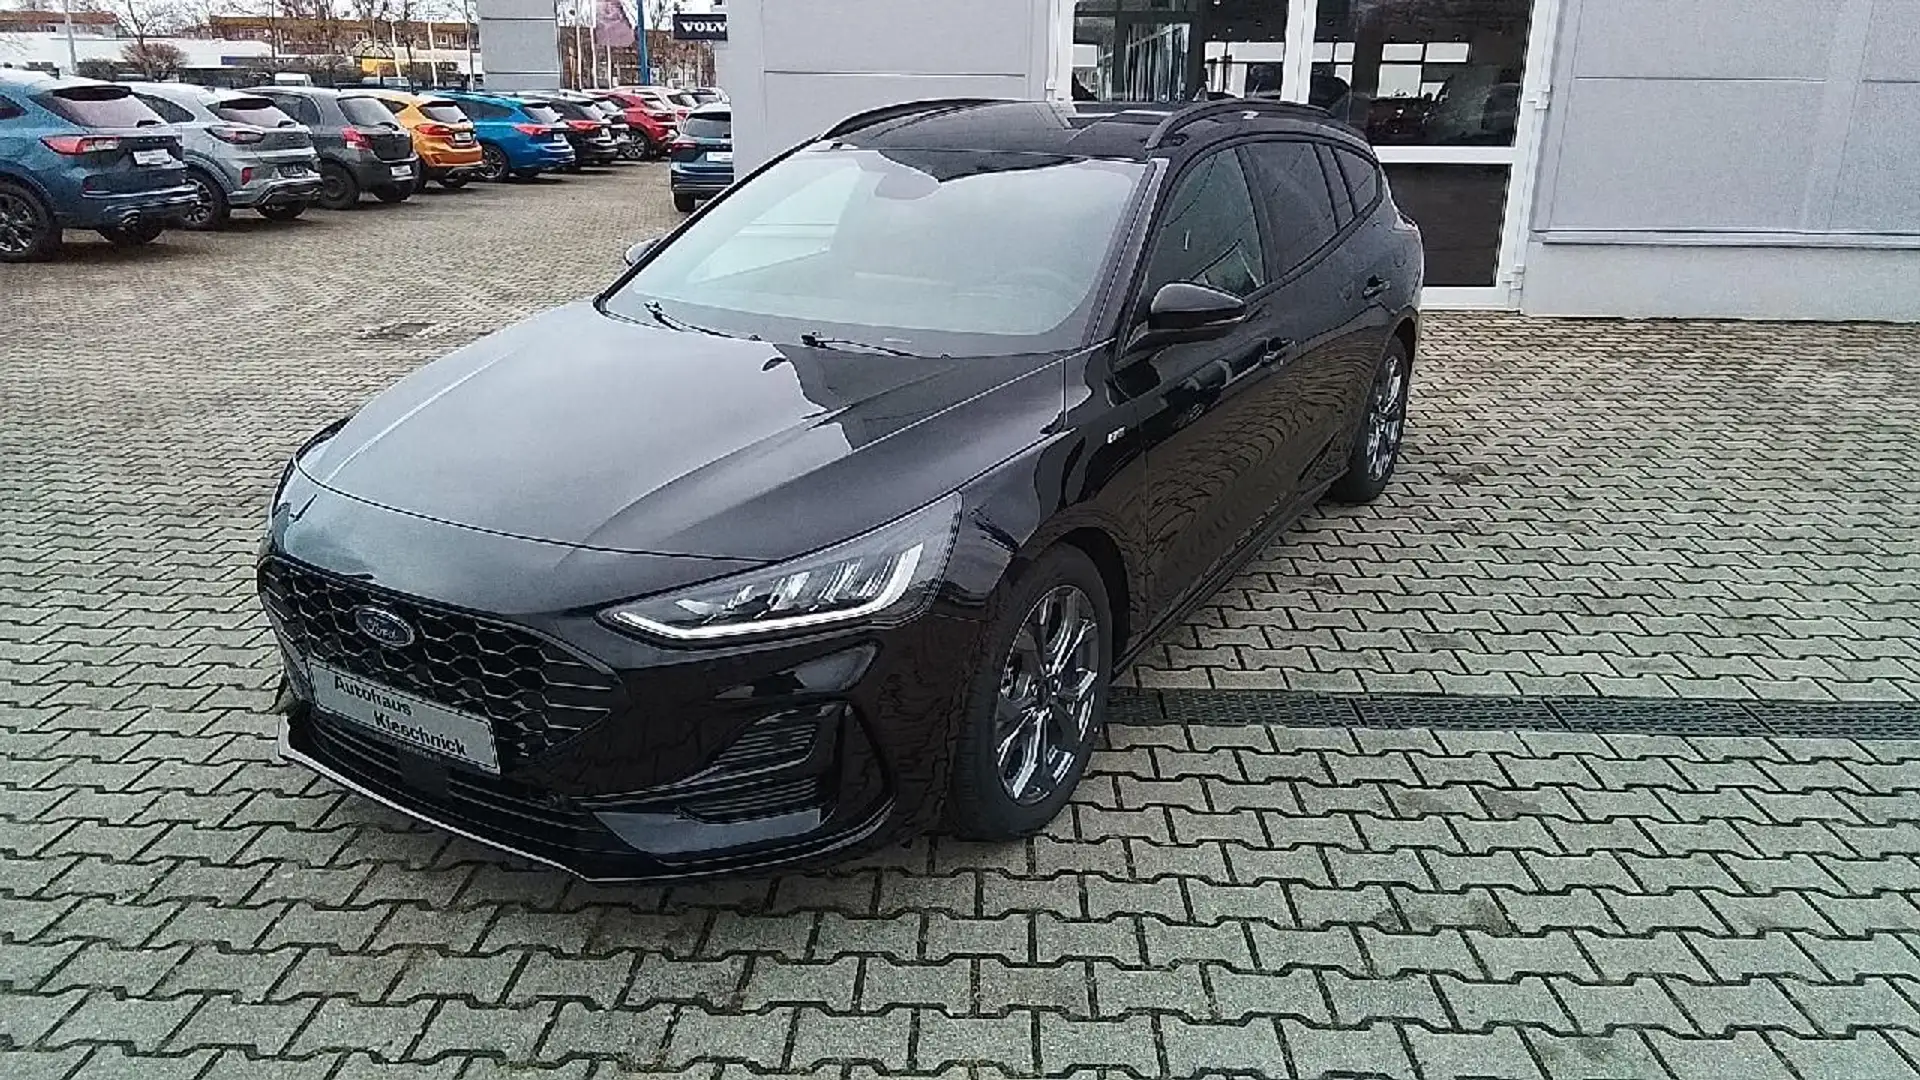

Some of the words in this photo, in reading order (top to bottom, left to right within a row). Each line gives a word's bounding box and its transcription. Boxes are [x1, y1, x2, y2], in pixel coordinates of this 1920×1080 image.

[365, 617, 400, 640] Ford
[334, 675, 413, 716] Autohaus
[373, 710, 468, 756] Kieschnick
